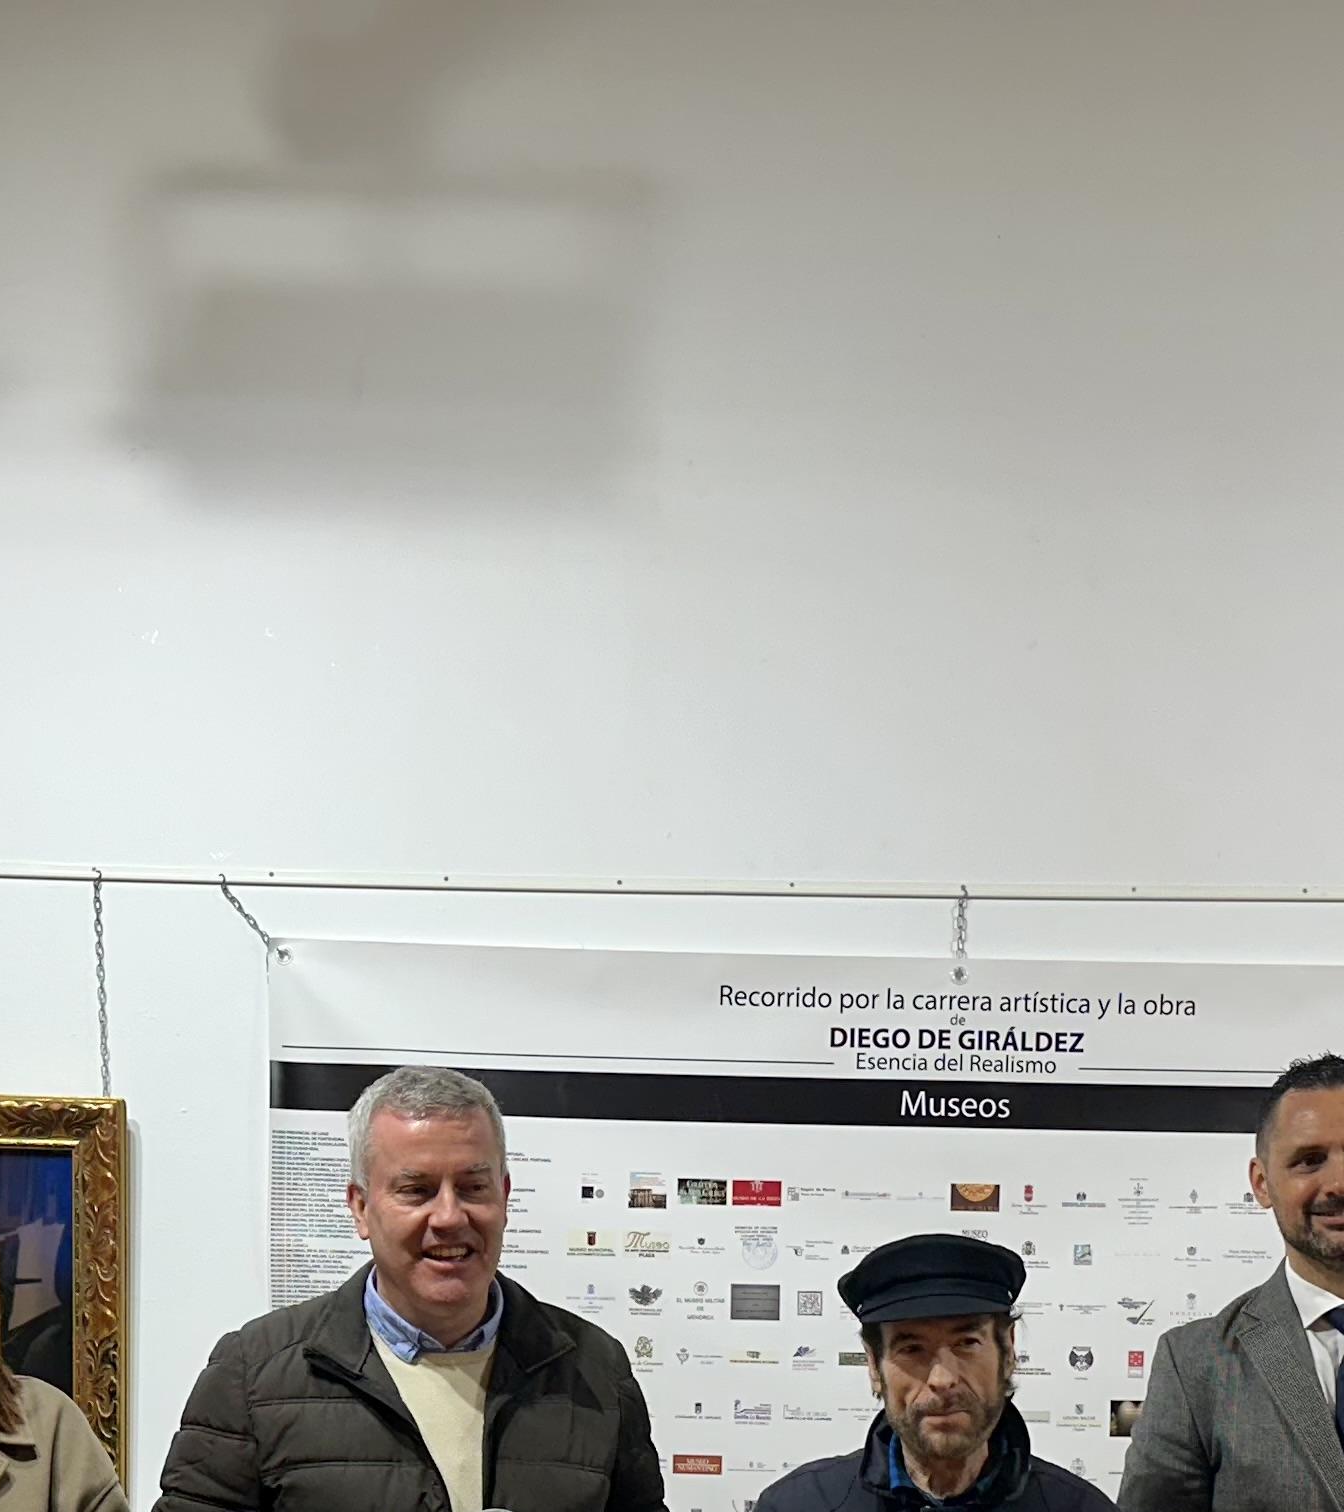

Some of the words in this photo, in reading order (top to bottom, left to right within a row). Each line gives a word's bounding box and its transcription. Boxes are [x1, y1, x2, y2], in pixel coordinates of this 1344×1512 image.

[718, 984, 834, 1010] Recorrido
[839, 992, 881, 1015] por
[886, 987, 906, 1011] la
[912, 994, 993, 1017] carrera
[999, 991, 1091, 1016] artística
[1097, 998, 1113, 1020] y
[1117, 992, 1137, 1016] la
[1143, 993, 1197, 1017] obra
[949, 1013, 966, 1026] de
[828, 1026, 911, 1050] DIEGO
[917, 1028, 953, 1051] DE
[957, 1026, 1085, 1053] GIRÁLDEZ
[856, 1052, 928, 1073] Esencia
[933, 1052, 965, 1073] del
[969, 1054, 1057, 1075] Realismo
[899, 1090, 1011, 1119] Museos
